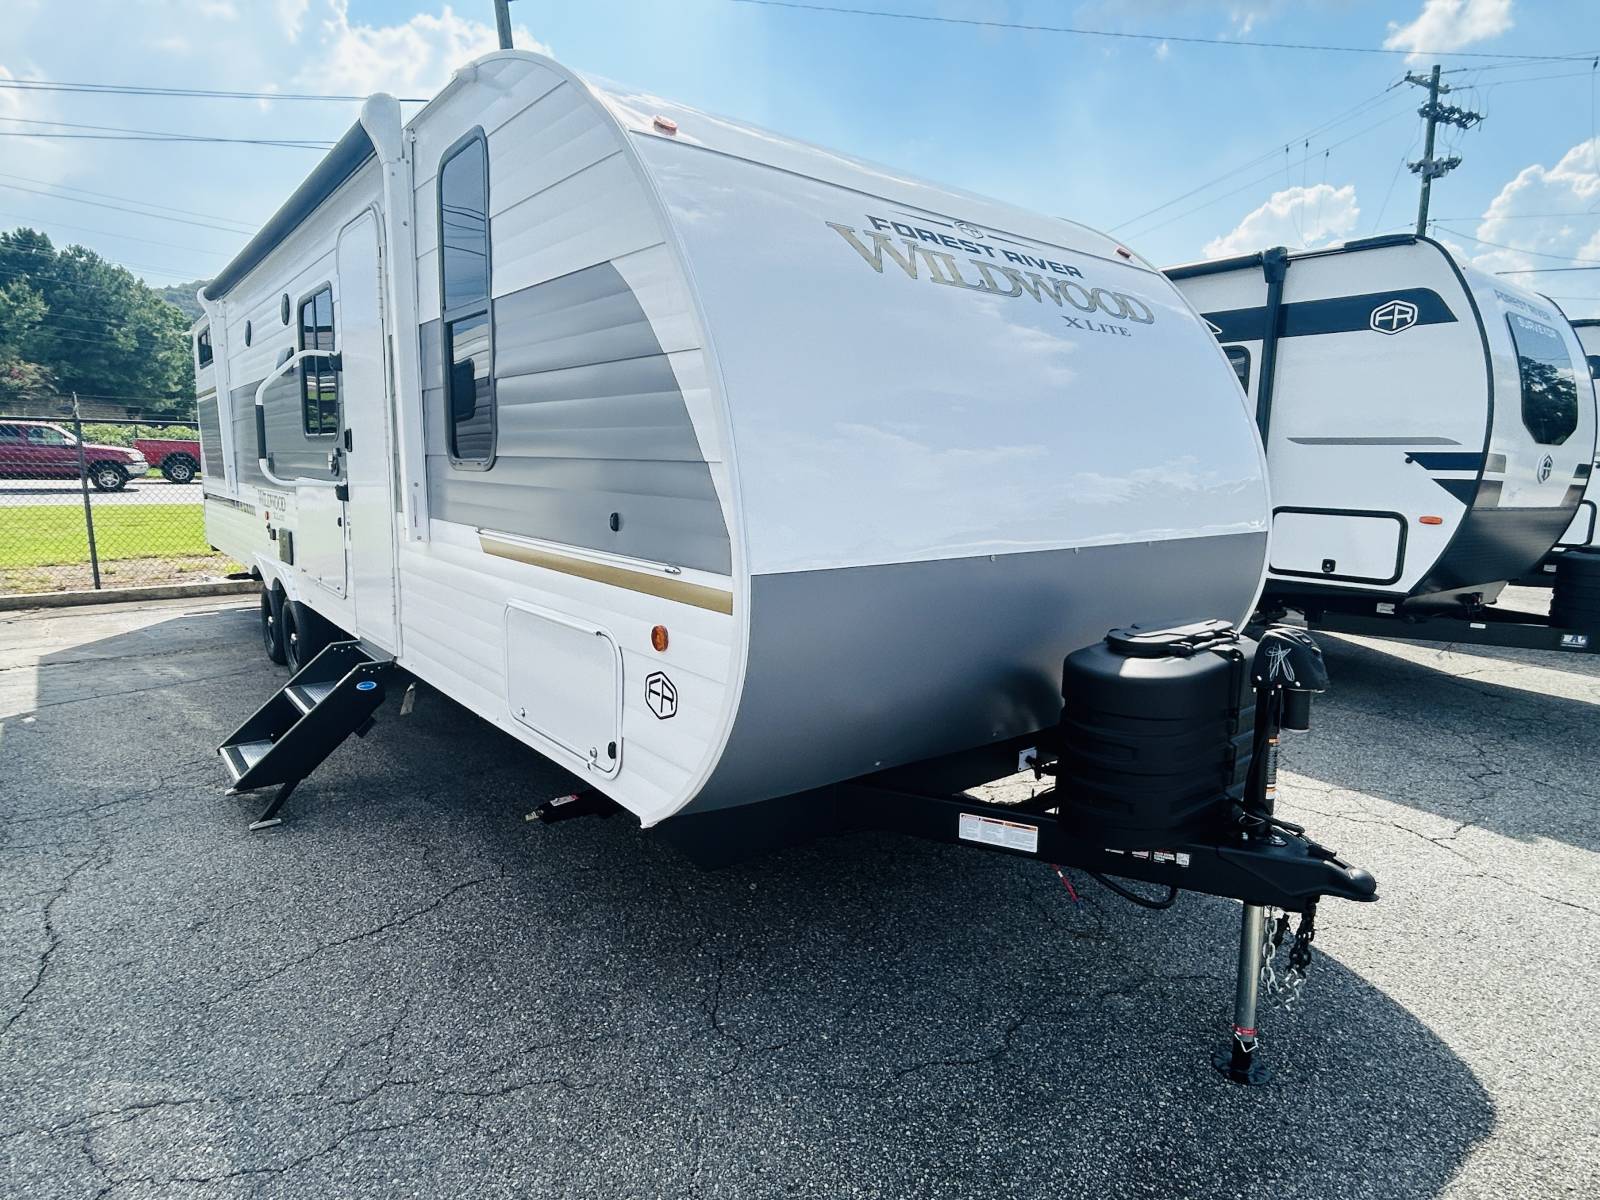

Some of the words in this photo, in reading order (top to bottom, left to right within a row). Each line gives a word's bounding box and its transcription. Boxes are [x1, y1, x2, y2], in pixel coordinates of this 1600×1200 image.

[825, 221, 1155, 325] WILDWOOD
[865, 214, 996, 258] FOREST
[1002, 249, 1084, 279] RIVER
